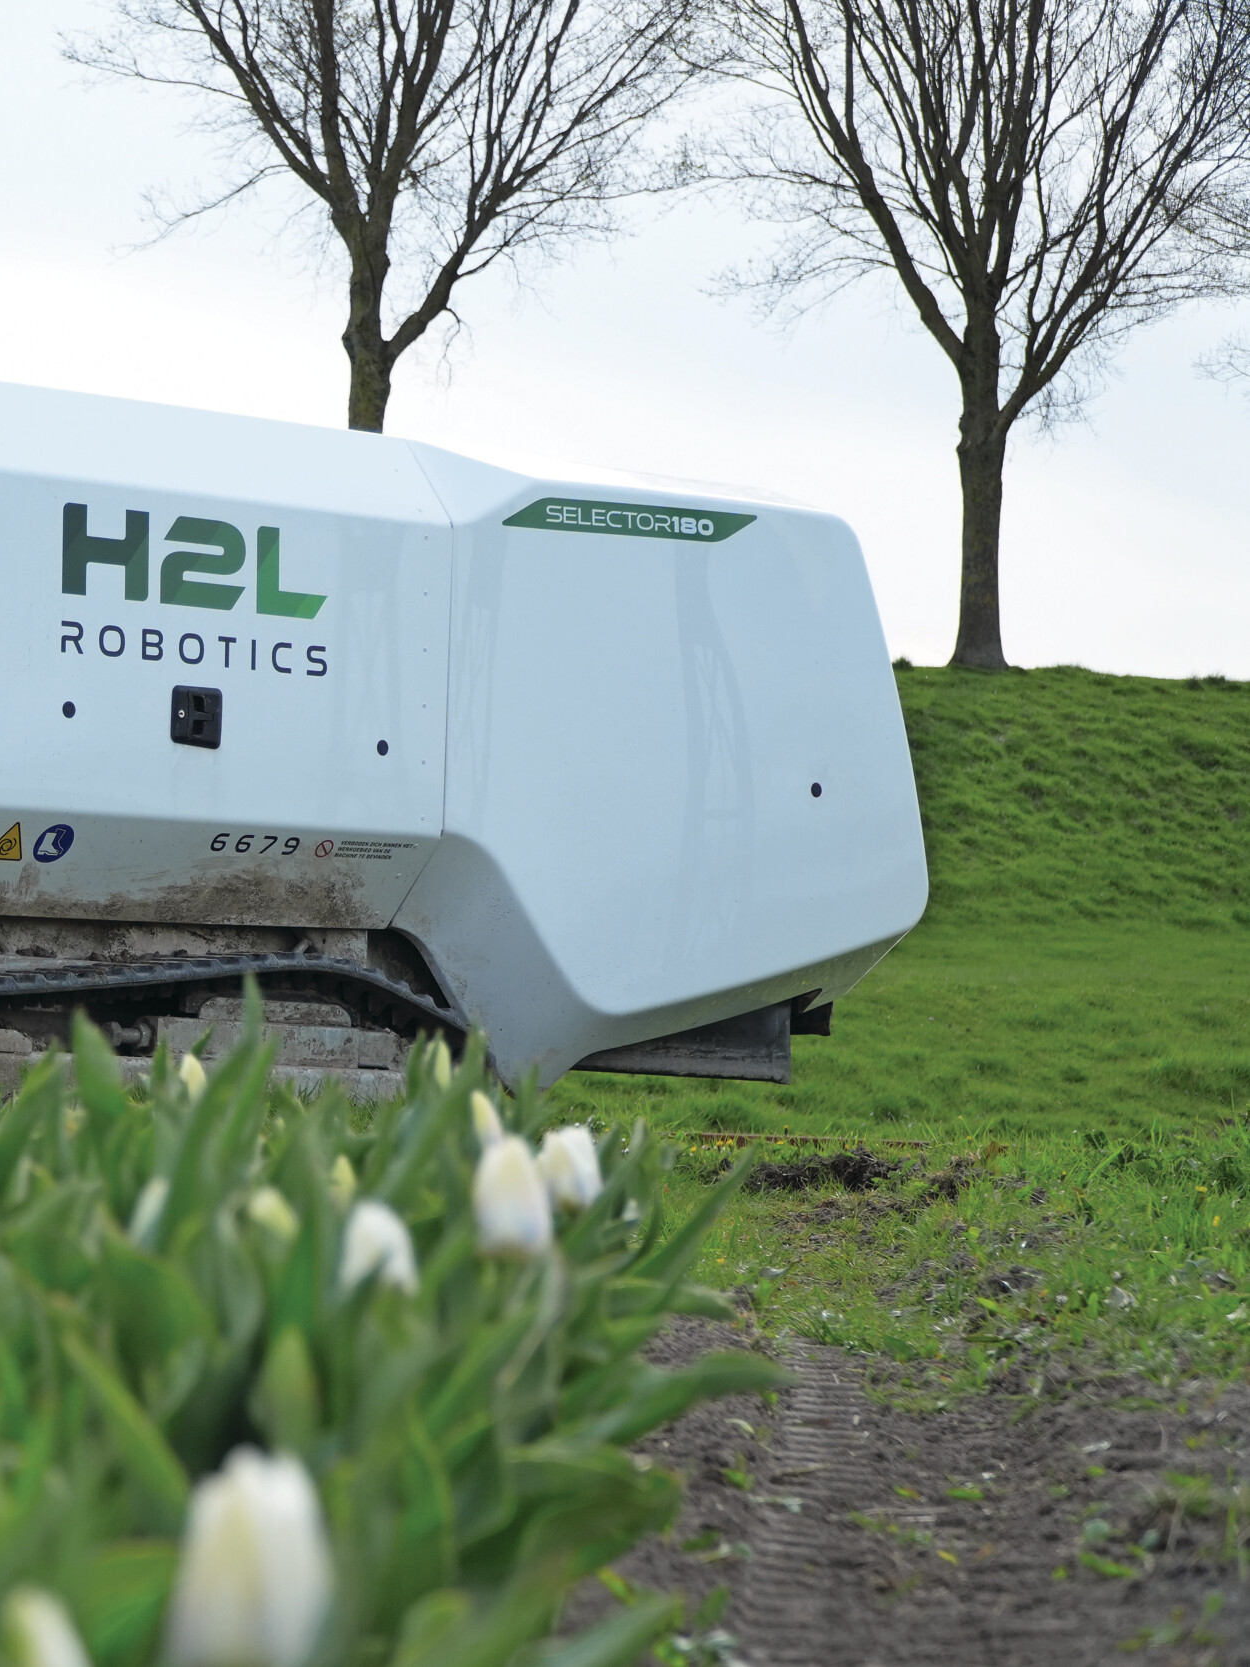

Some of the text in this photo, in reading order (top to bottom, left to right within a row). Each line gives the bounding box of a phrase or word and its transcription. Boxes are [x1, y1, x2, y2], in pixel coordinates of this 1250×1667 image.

[546, 505, 714, 536] SELECTOR180
[62, 502, 328, 619] H2L
[60, 620, 328, 677] ROBOTICS
[210, 833, 301, 855] 6679
